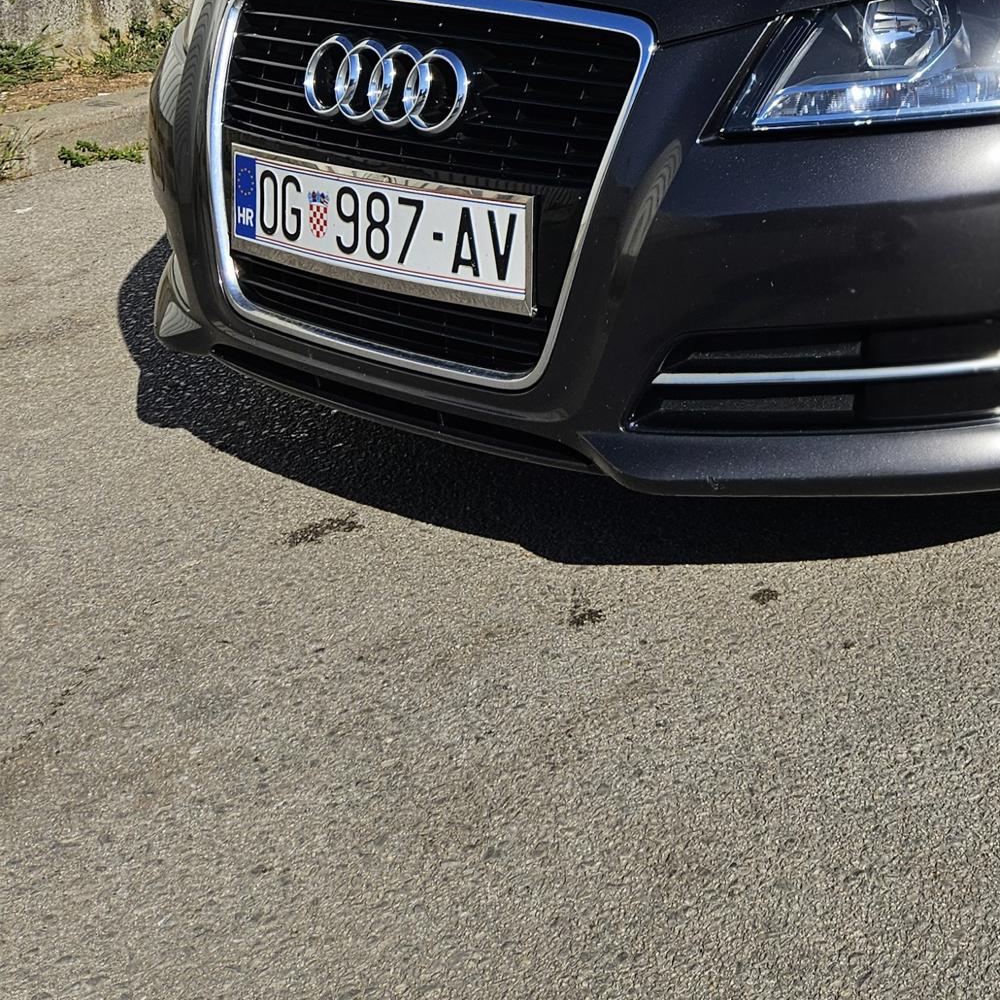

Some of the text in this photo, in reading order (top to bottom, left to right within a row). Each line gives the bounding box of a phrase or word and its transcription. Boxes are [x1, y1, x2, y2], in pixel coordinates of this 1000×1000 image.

[237, 206, 254, 228] HR
[260, 169, 517, 281] OG 987-AV
